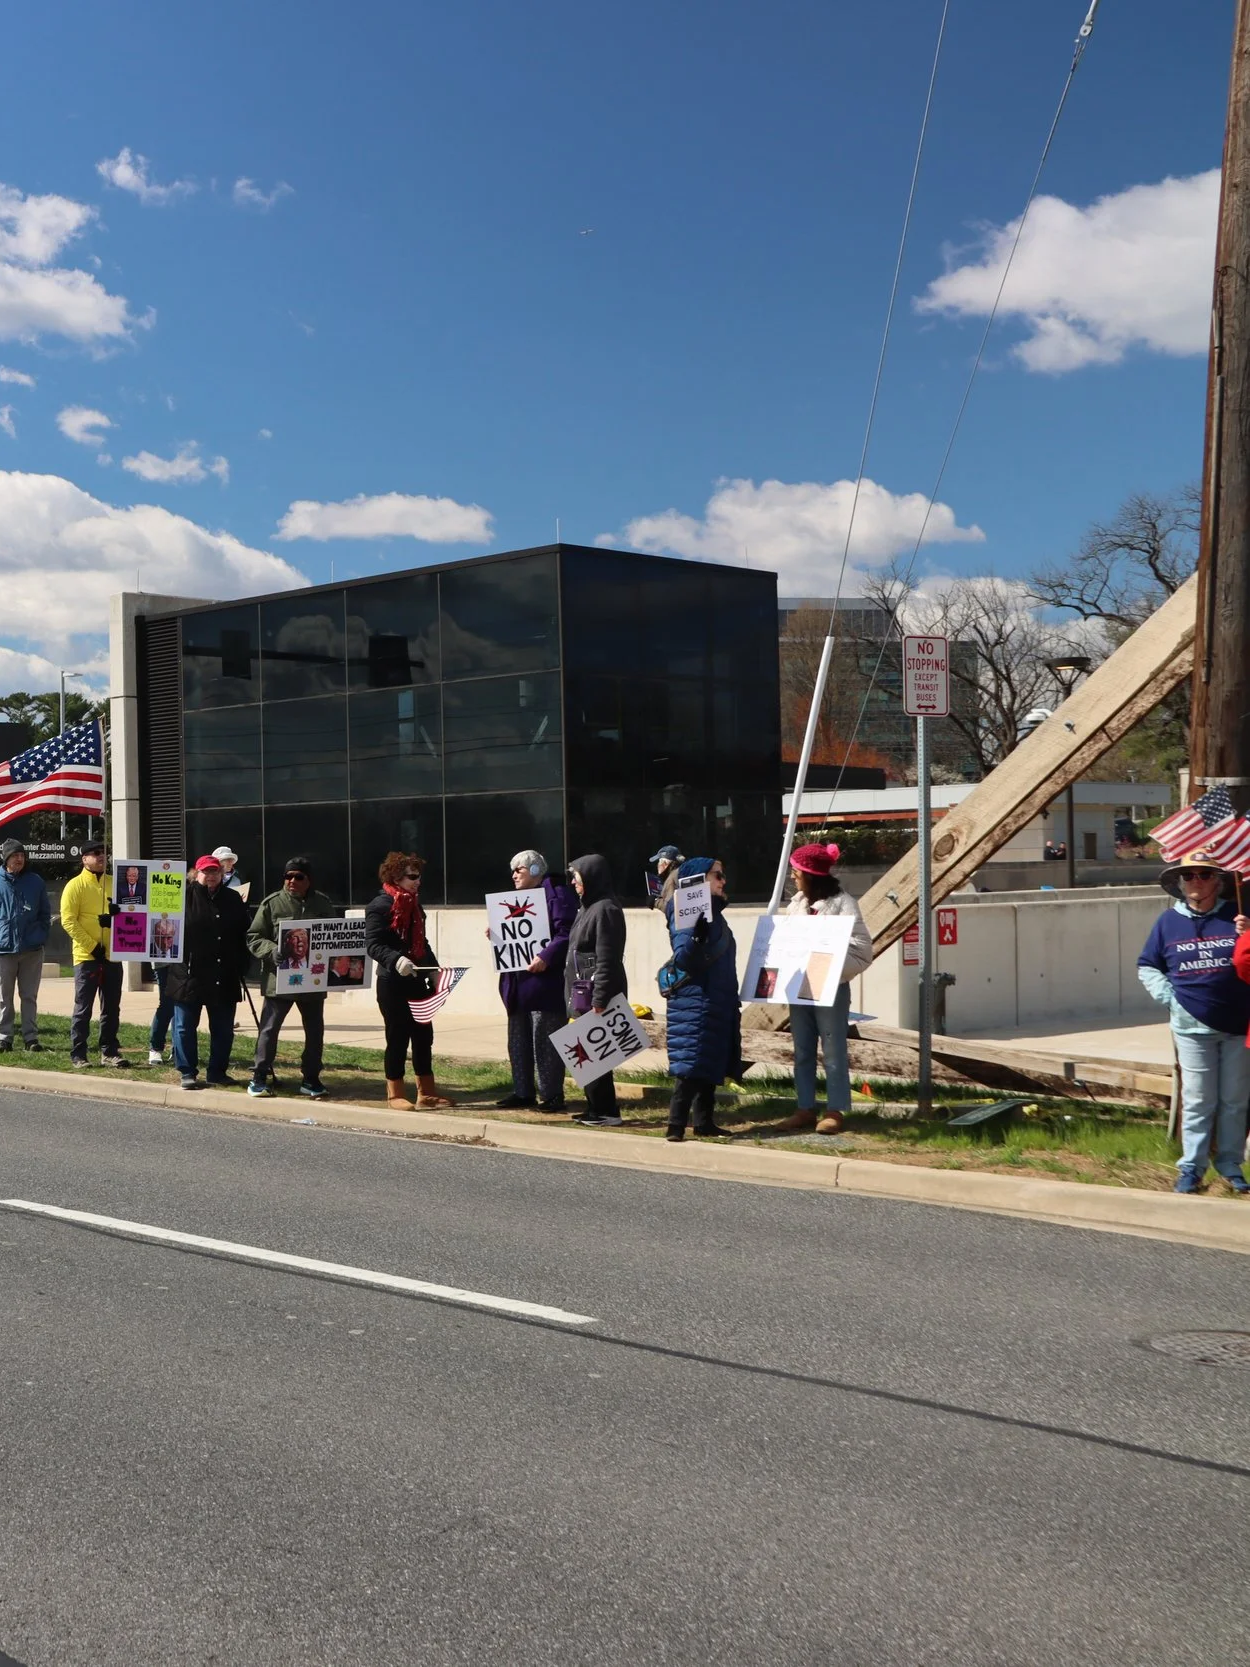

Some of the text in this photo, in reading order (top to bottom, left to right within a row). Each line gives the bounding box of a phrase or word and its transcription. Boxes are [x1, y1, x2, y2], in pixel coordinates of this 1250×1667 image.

[918, 642, 934, 655] NO
[907, 657, 946, 671] STOPPING
[914, 672, 938, 681] EXCEPT
[913, 683, 939, 691] TRANSIT
[916, 693, 937, 702] BUSES
[40, 843, 65, 851] Station
[28, 851, 65, 859] Mezzanine
[152, 874, 182, 888] No King
[687, 890, 703, 900] SAVE
[125, 916, 138, 925] No
[312, 923, 322, 931] WE
[323, 923, 343, 931] WANT
[344, 922, 349, 930] A
[501, 918, 533, 941] NO
[116, 927, 142, 936] Donald
[312, 933, 325, 941] NOT
[327, 932, 331, 940] A
[1176, 938, 1235, 952] NO KINGS
[1199, 950, 1213, 959] IN
[601, 1005, 643, 1057] KINGS!
[586, 1026, 617, 1061] NO
